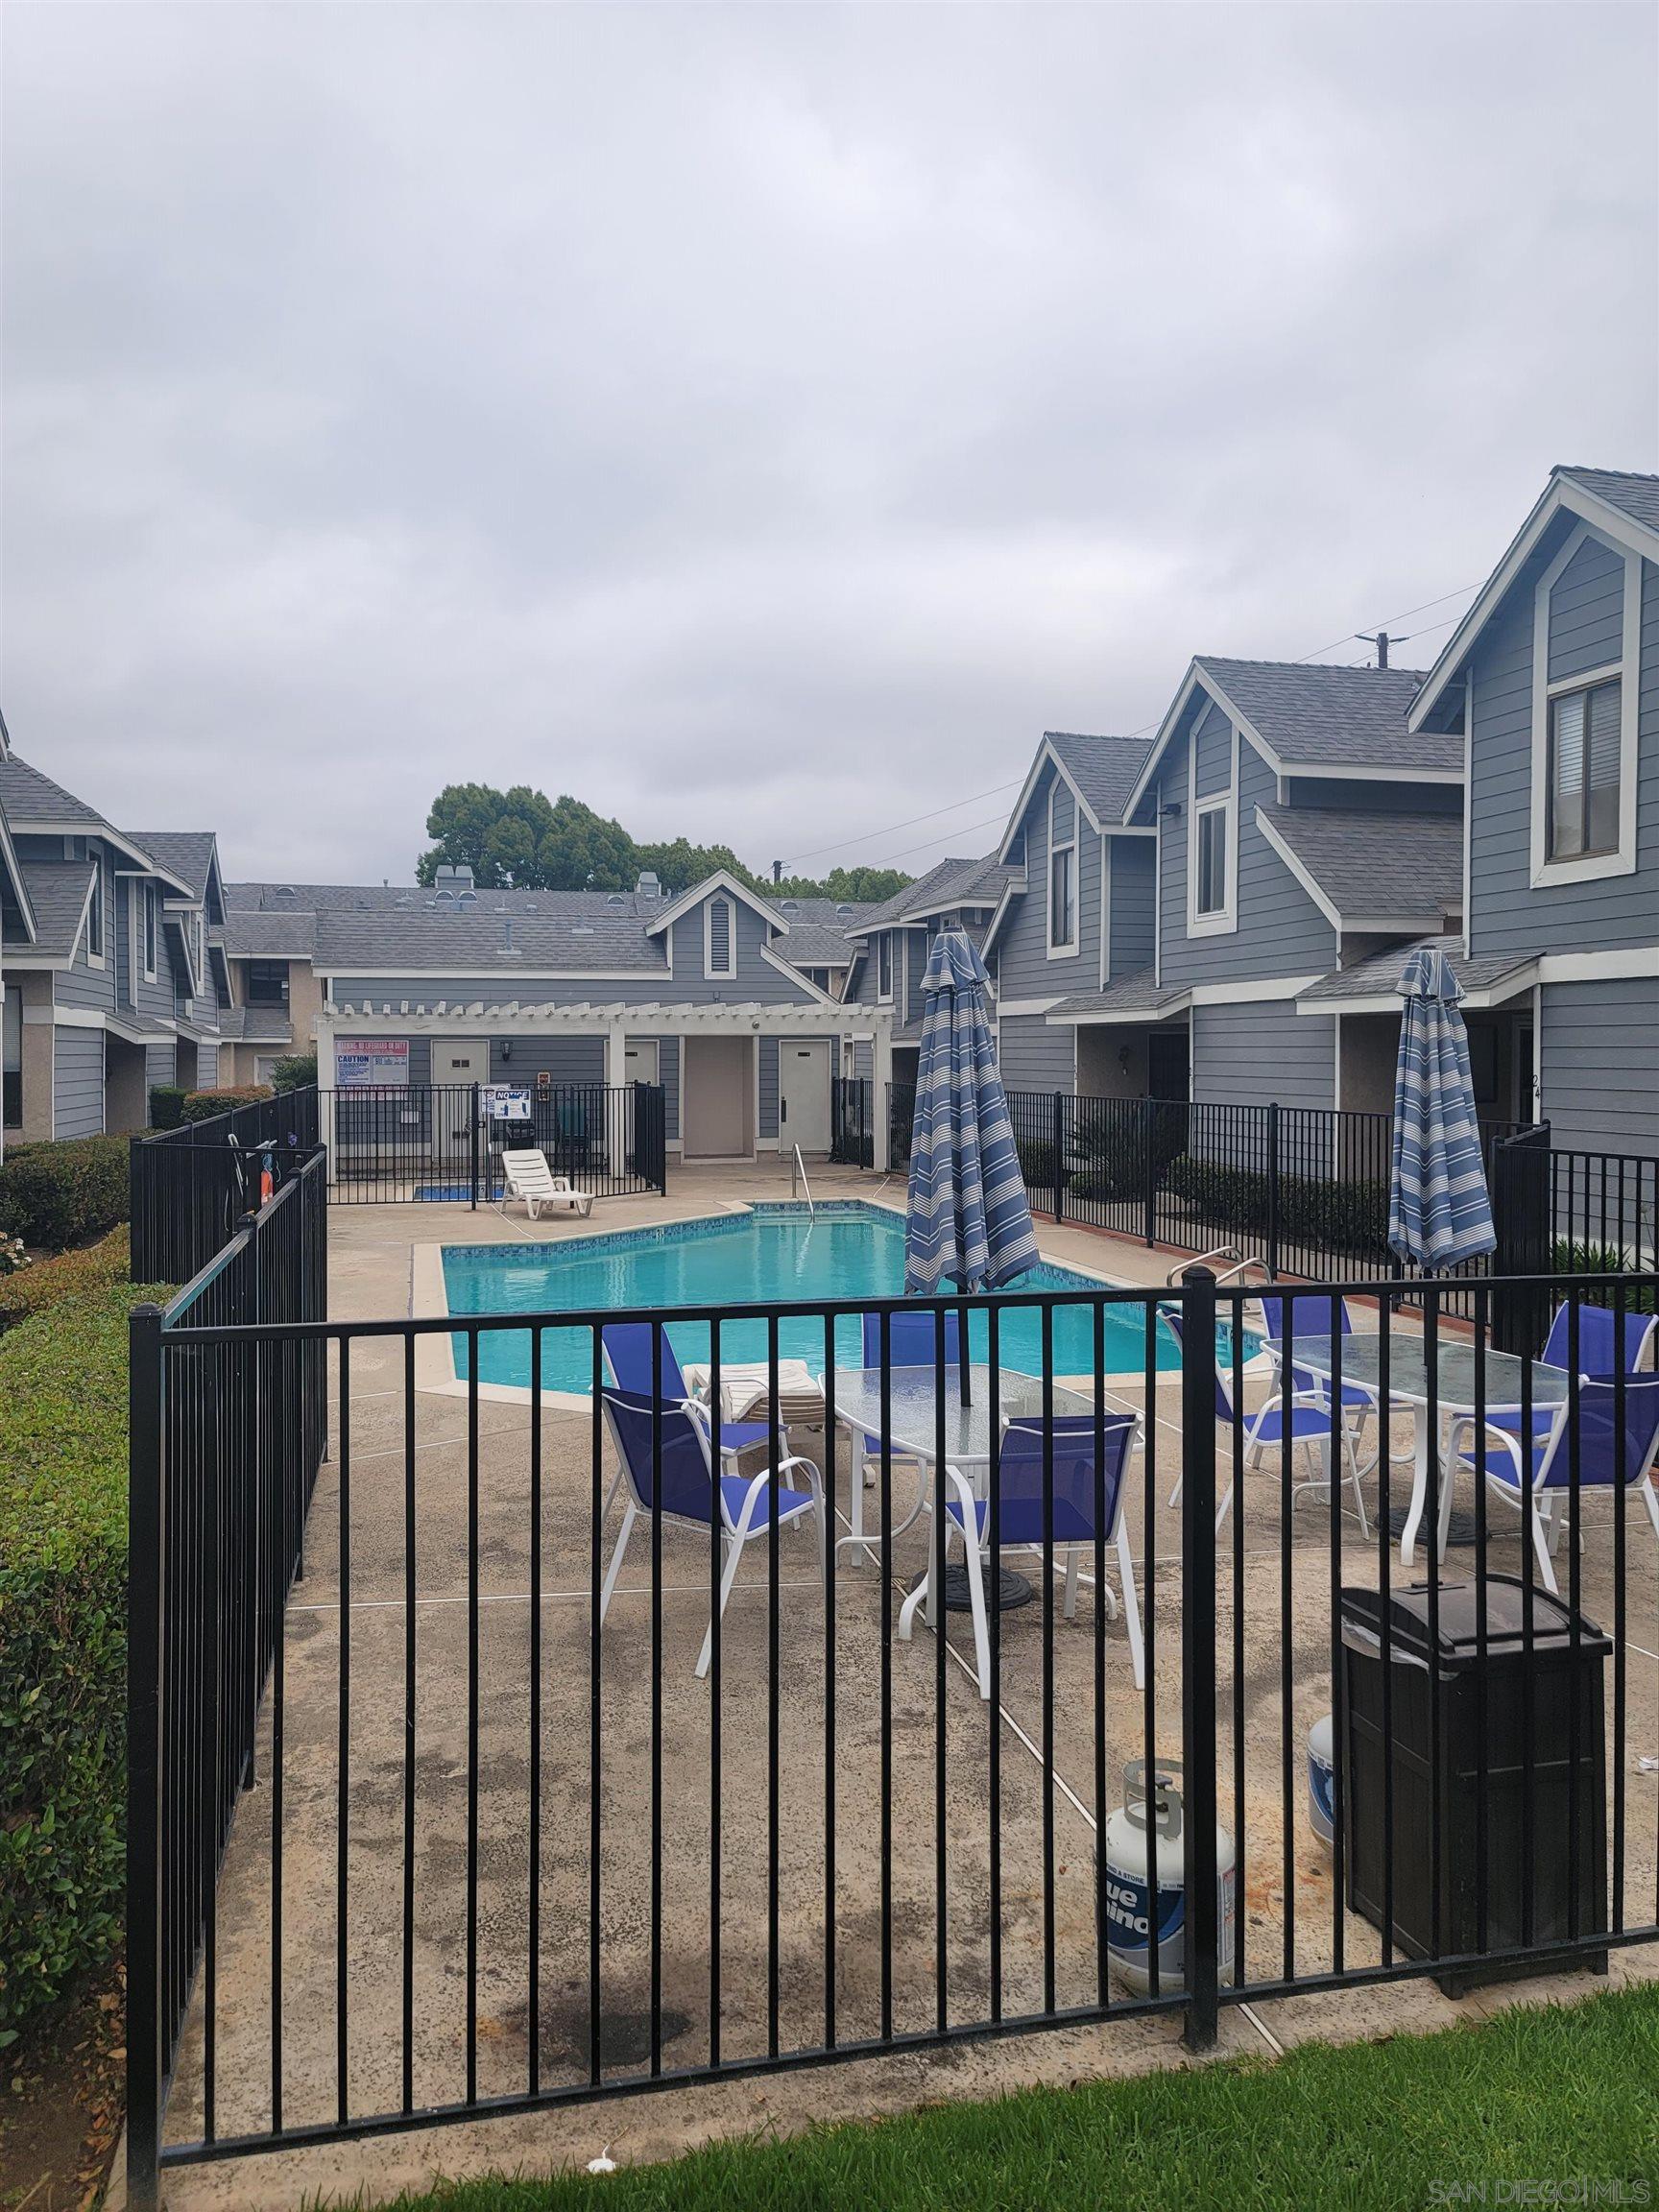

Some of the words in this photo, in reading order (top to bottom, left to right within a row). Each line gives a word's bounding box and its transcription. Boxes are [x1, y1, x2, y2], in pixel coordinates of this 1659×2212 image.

[1532, 1074, 1540, 1099] 24
[1123, 1872, 1144, 1885] STORE
[1106, 1881, 1138, 1908] ue
